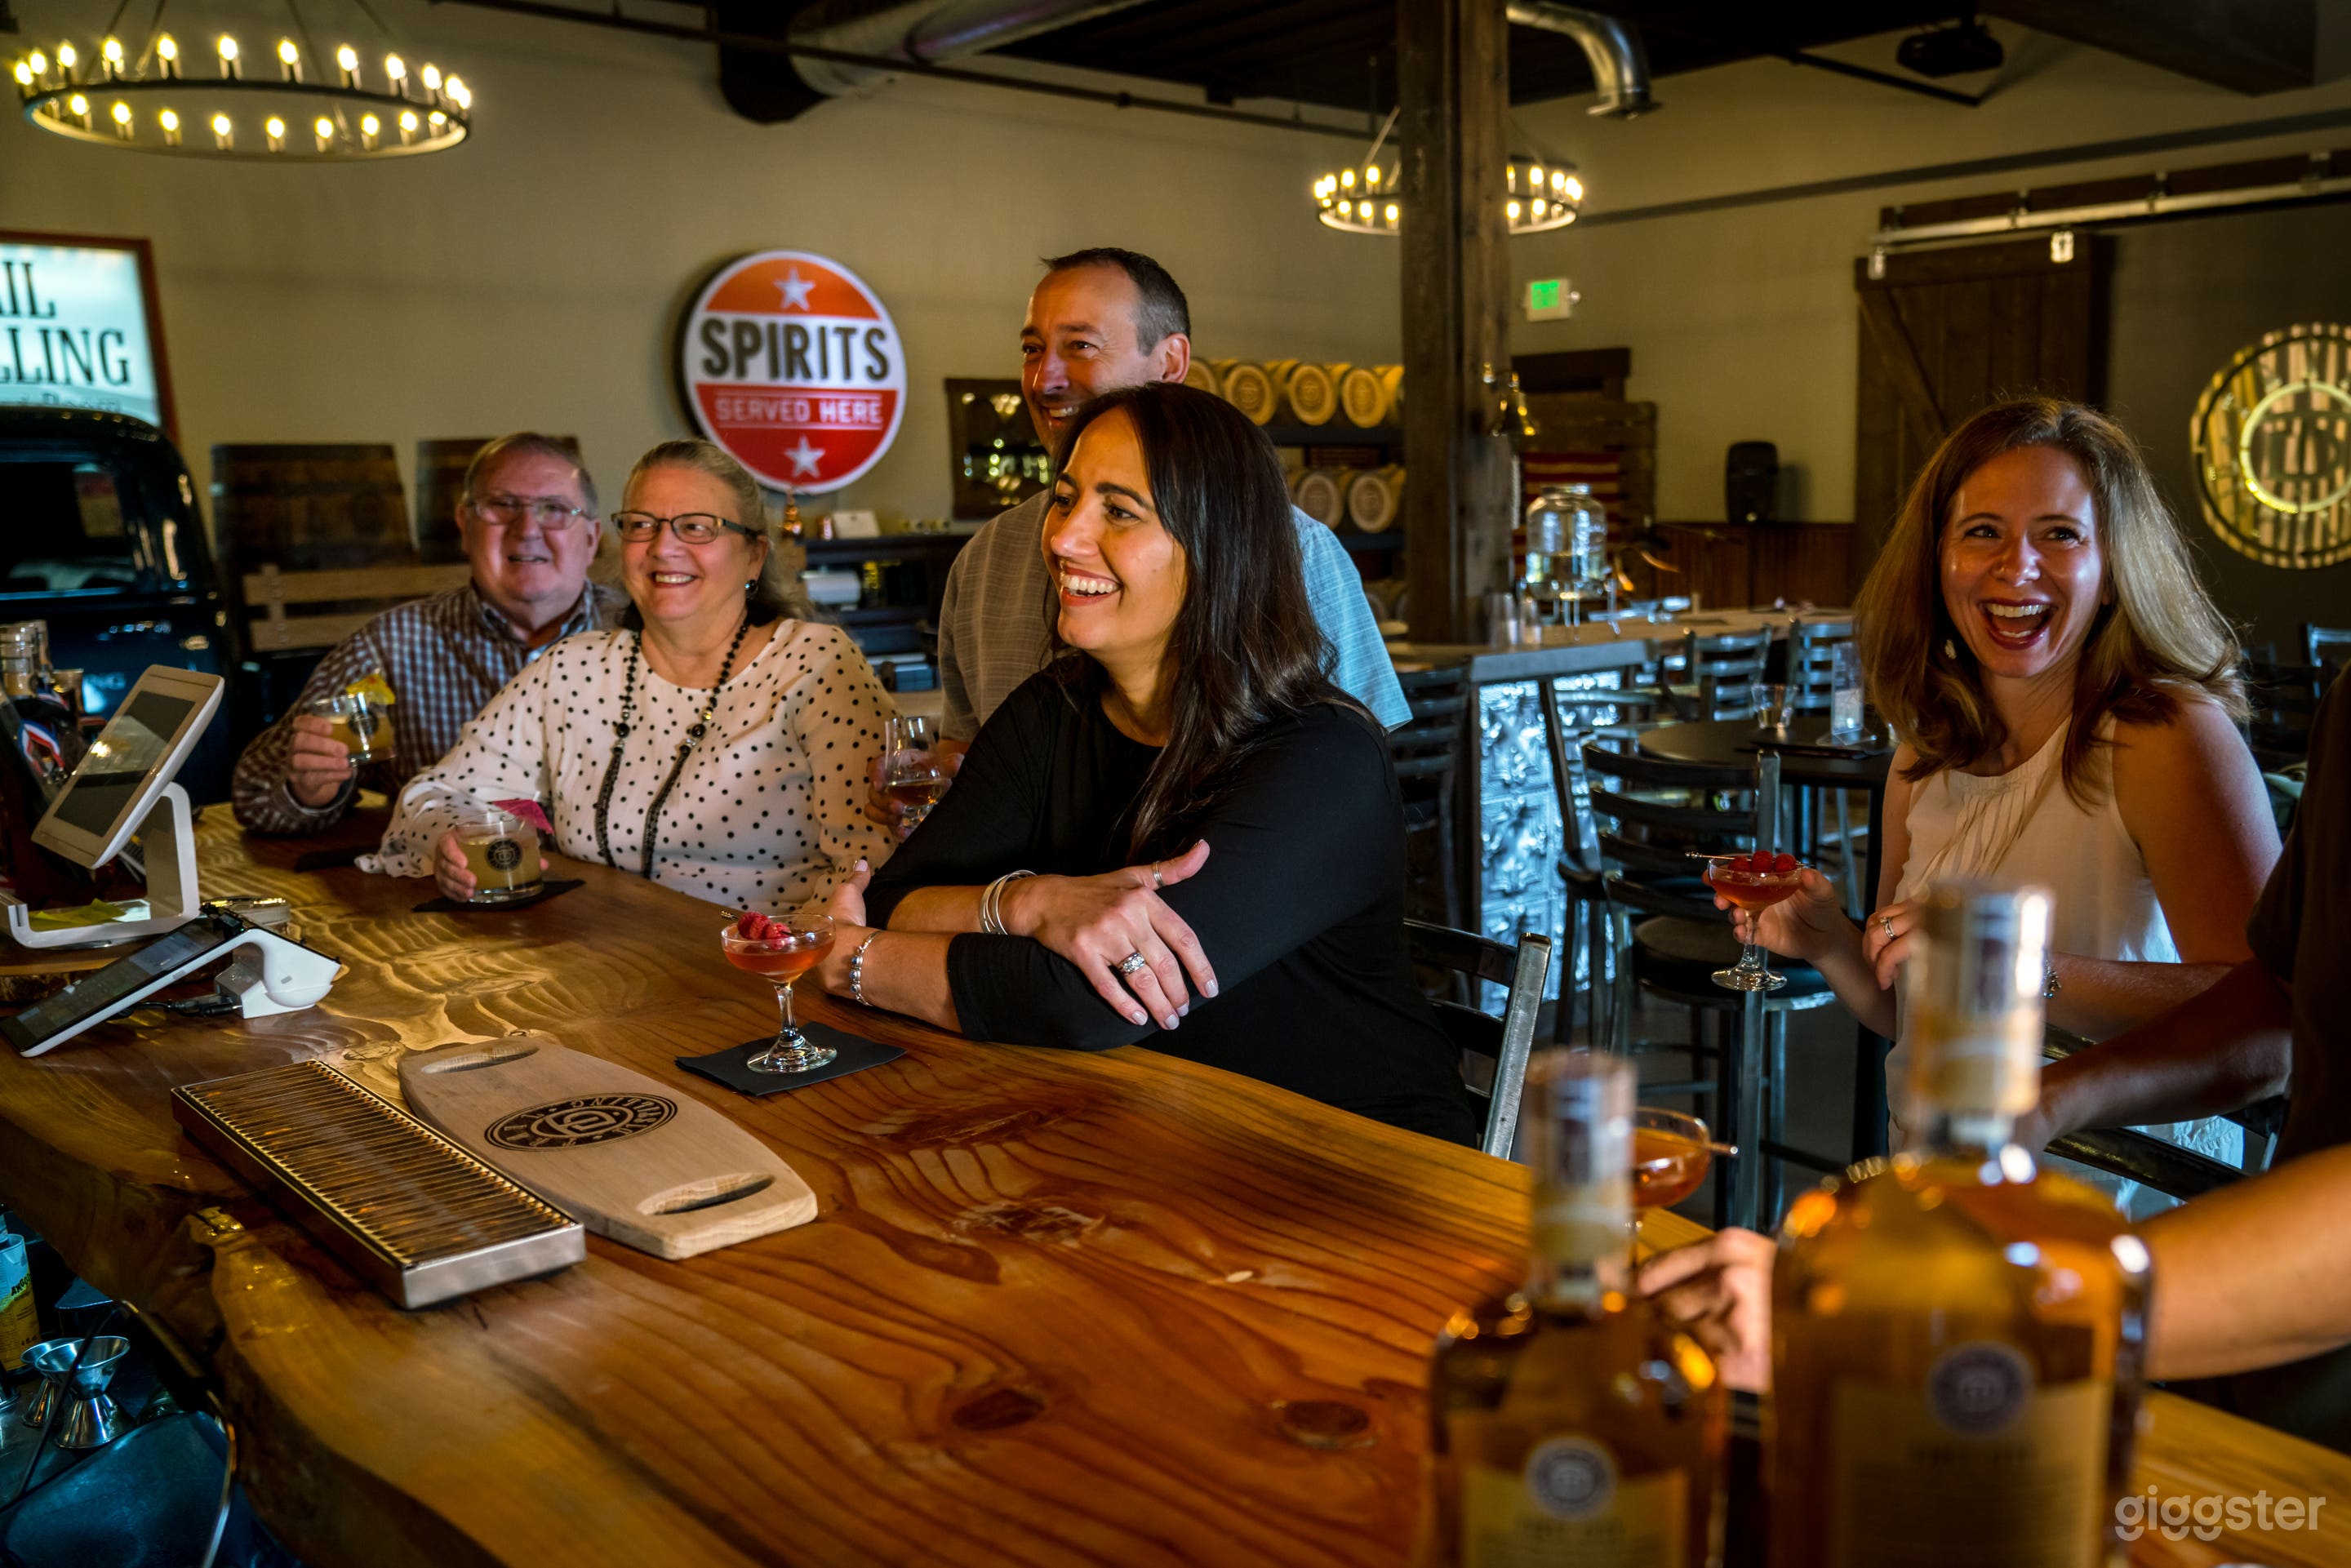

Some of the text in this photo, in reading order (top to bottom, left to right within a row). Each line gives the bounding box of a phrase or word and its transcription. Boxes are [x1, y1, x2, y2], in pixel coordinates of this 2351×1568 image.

[0, 260, 56, 318] IL
[700, 318, 889, 381] SPIRITS
[714, 397, 882, 424] SERVED HERE
